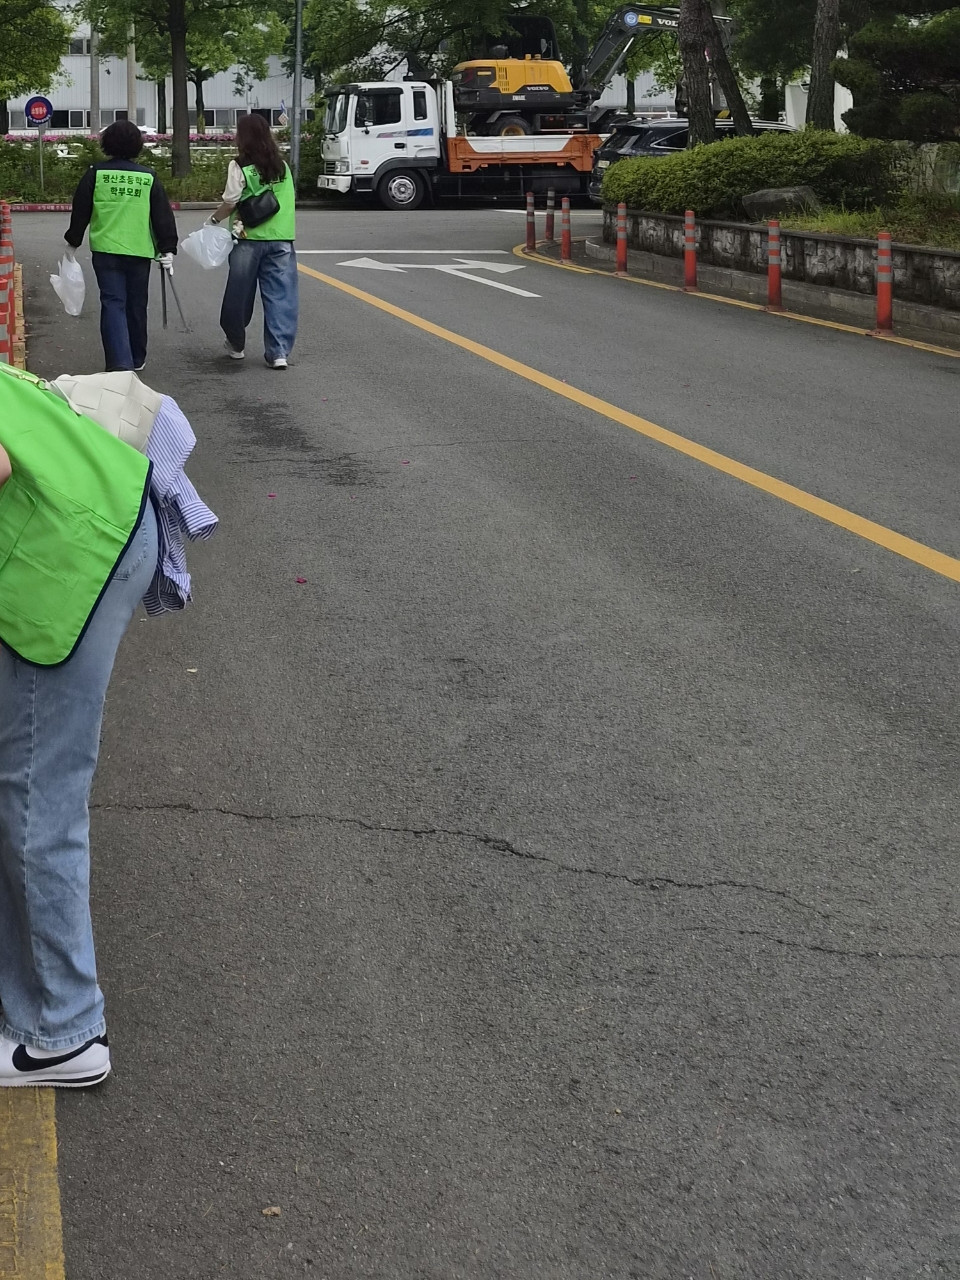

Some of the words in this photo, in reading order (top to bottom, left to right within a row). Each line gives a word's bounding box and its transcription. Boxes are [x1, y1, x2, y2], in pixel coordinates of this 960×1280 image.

[657, 18, 678, 27] VOL
[102, 174, 151, 186] 평산초등학교
[110, 186, 142, 198] 학부모회
